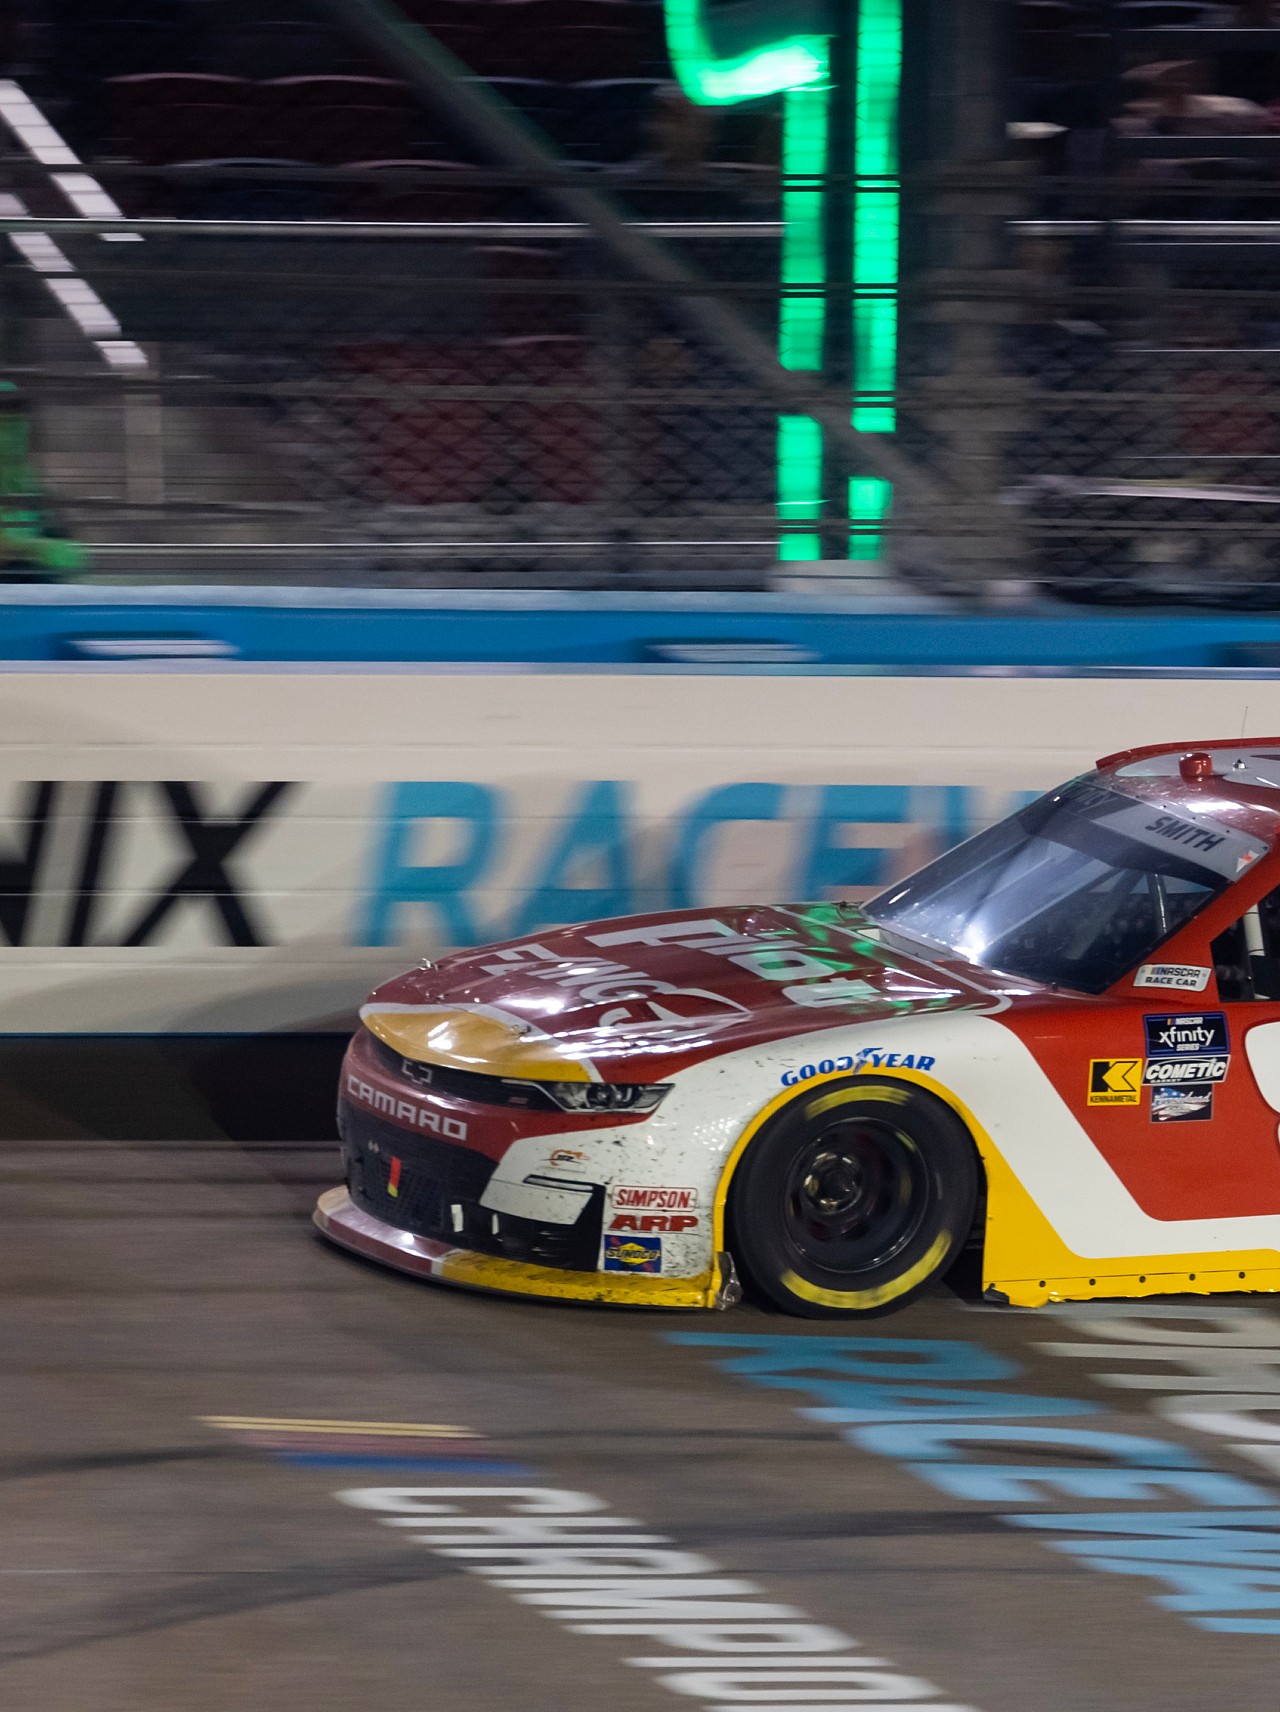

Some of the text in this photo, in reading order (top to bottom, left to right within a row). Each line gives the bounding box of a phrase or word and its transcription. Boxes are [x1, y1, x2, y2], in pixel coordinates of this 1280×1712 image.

[1145, 816, 1226, 852] SMITH
[1145, 977, 1197, 987] RACE CAR
[1158, 967, 1200, 978] NASCAR
[1159, 1026, 1215, 1047] xfinity
[1145, 1060, 1226, 1080] COMETIC
[347, 1074, 468, 1141] CAMARO
[616, 1189, 691, 1208] SIMPSON
[609, 1214, 699, 1231] ARP
[606, 1247, 660, 1260] SUNOCO
[331, 1486, 985, 1712] CHAMPIO
